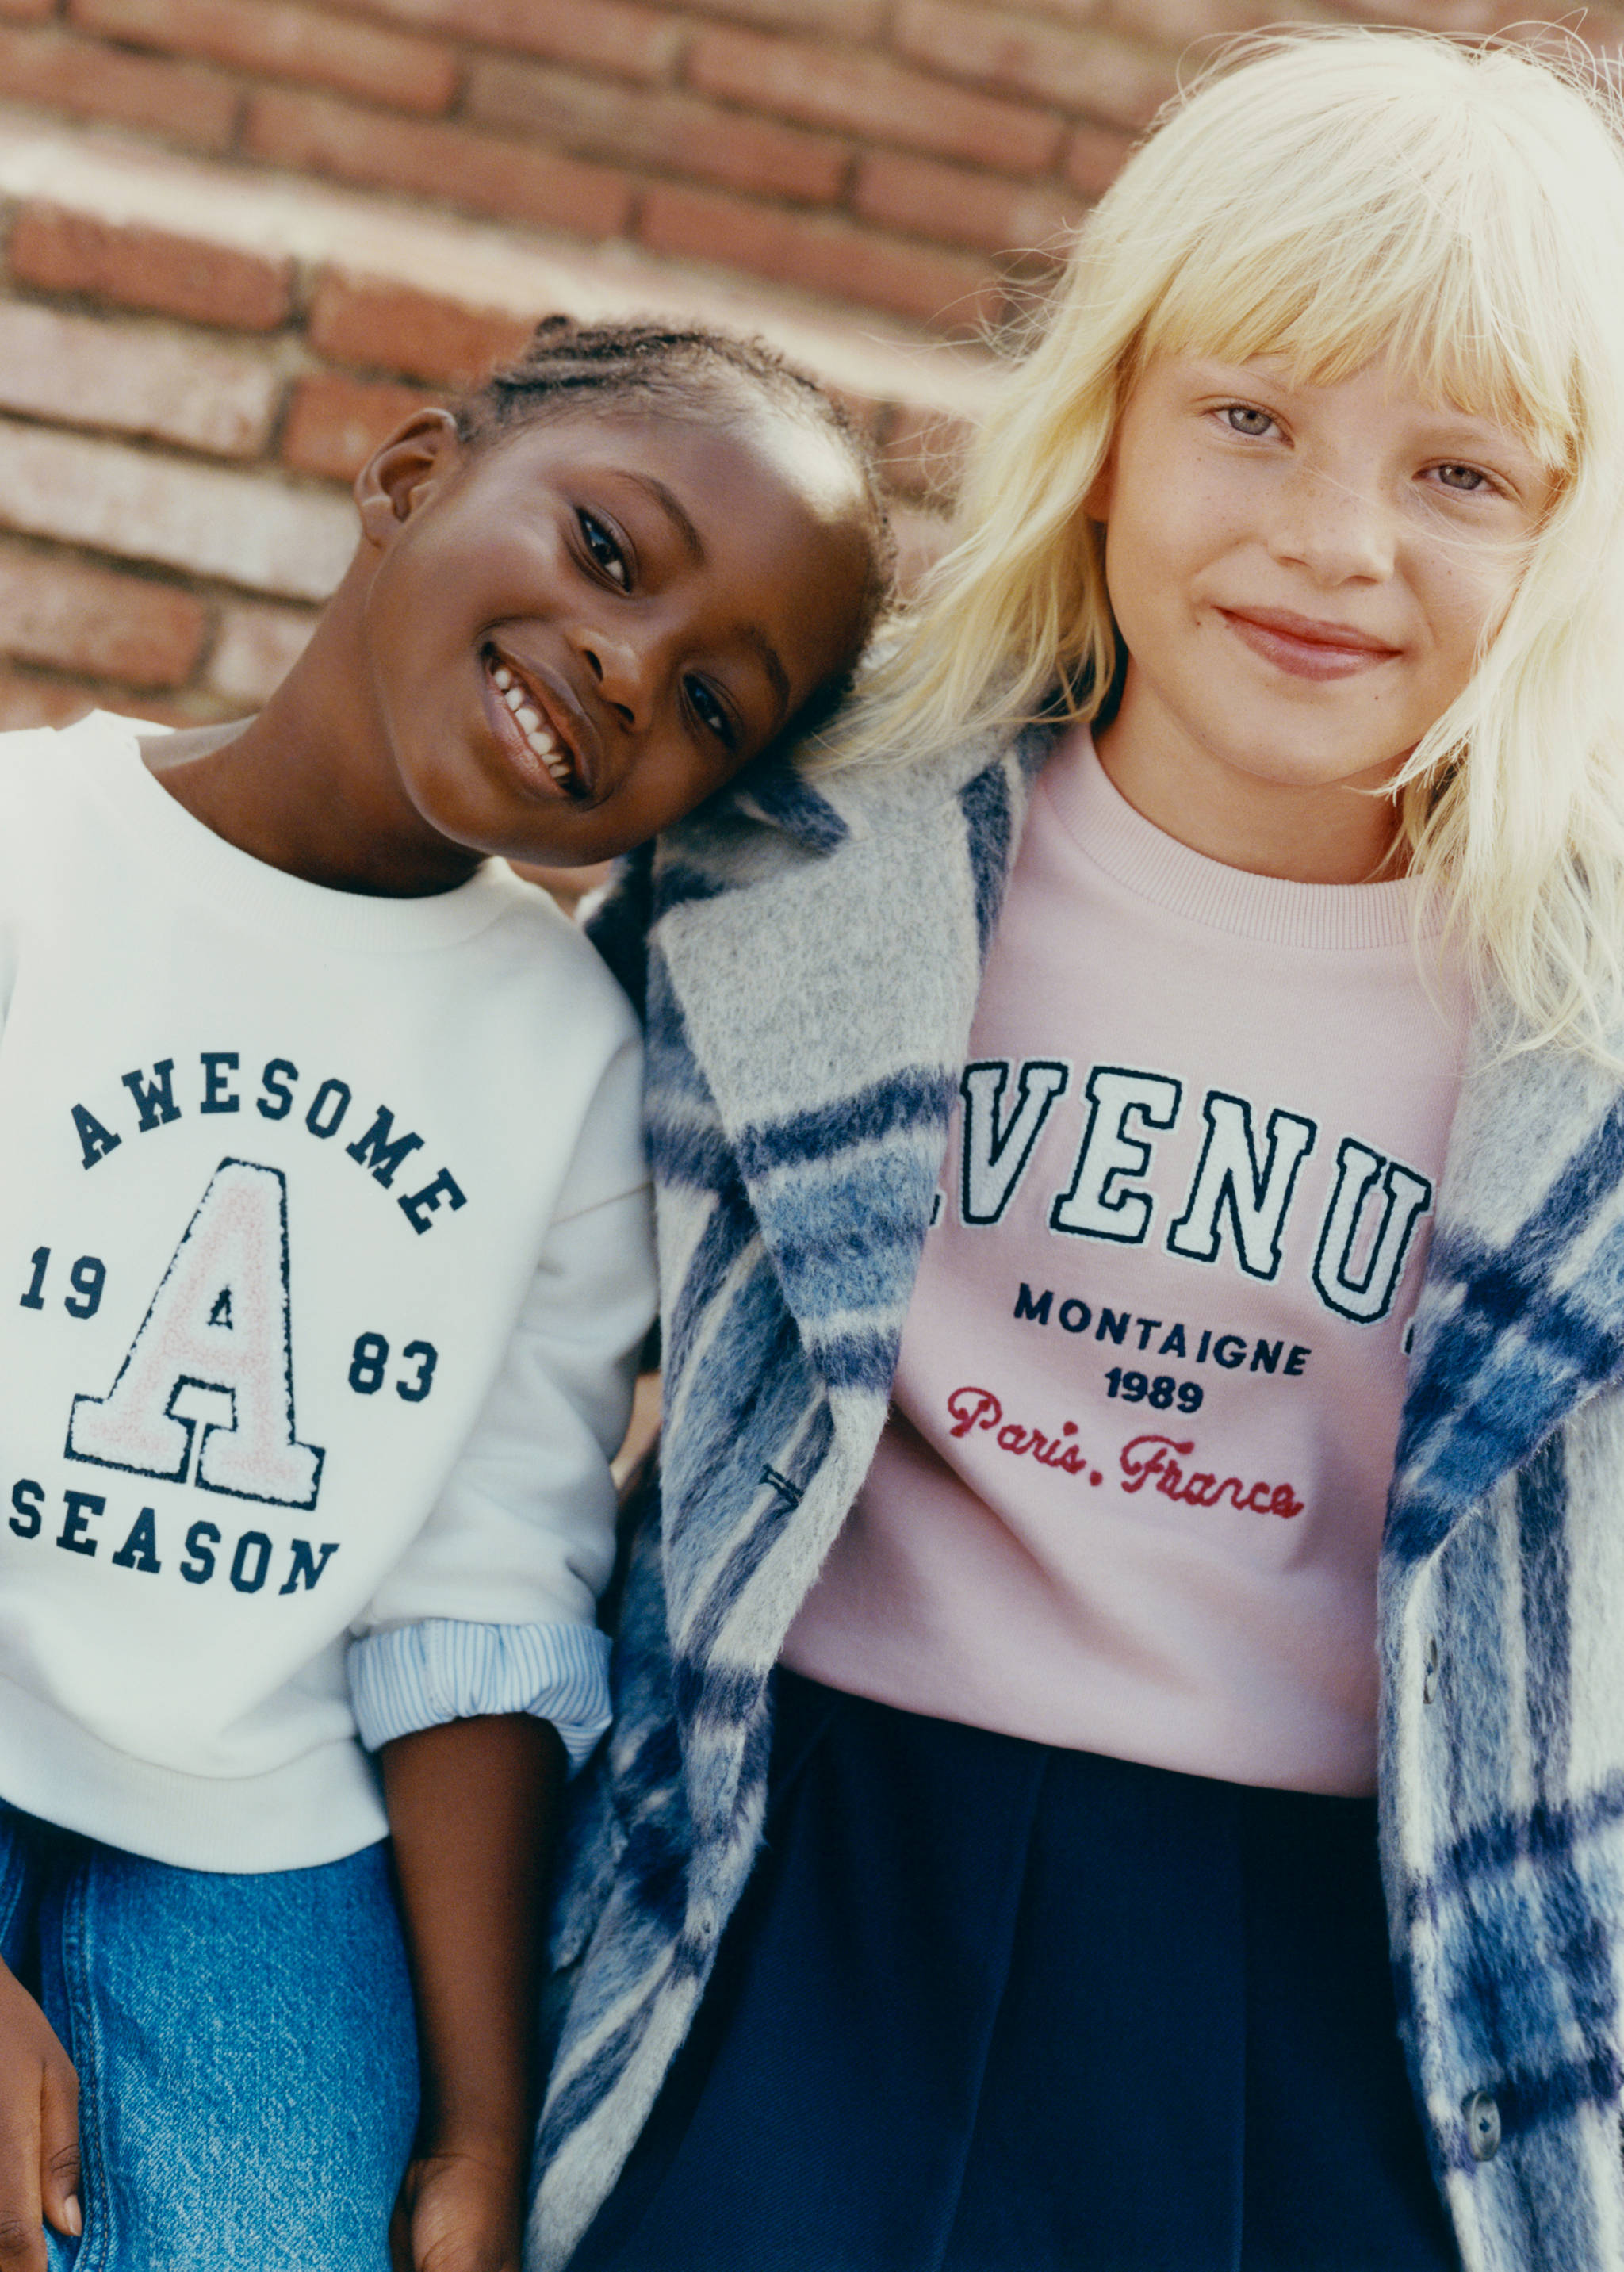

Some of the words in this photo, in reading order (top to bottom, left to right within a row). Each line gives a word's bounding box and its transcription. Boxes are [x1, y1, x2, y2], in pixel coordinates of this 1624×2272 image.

[71, 1052, 468, 1236] AWESOME
[929, 1060, 1433, 1358] VENU
[19, 1246, 107, 1320] 19
[1013, 1282, 1312, 1377] MONTAIGNE
[63, 1156, 326, 1511] A
[348, 1331, 439, 1403] 83
[1105, 1366, 1205, 1413] 1989
[1119, 1435, 1305, 1519] France
[8, 1478, 340, 1596] SEASON
